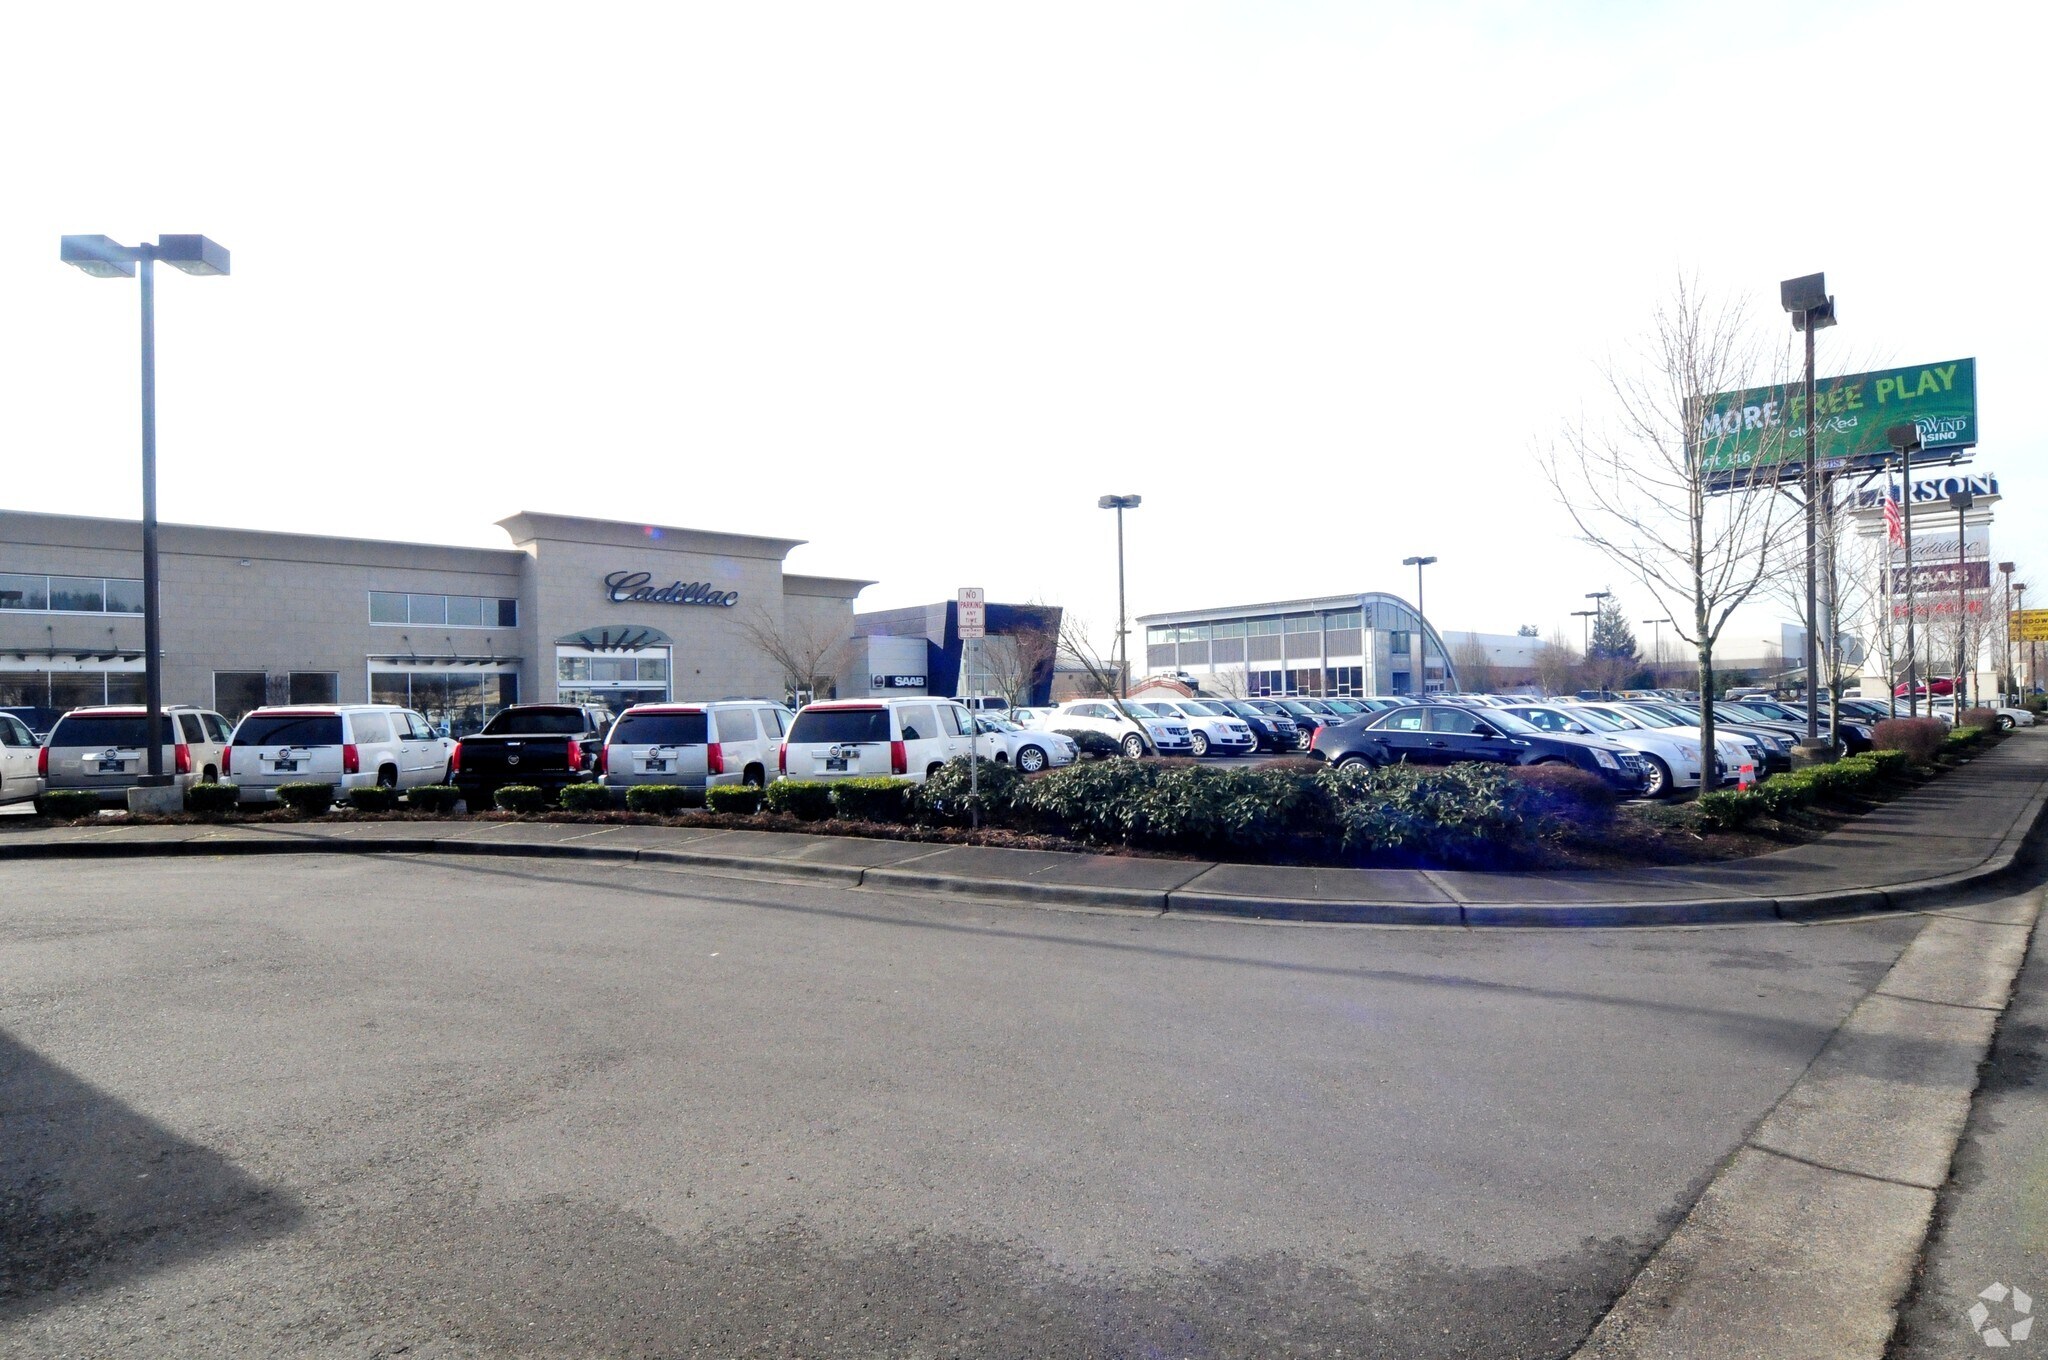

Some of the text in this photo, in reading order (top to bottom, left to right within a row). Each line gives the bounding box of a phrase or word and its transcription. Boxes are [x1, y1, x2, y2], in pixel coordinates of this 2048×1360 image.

[1702, 364, 1957, 439] MORE FREE PLAY
[1822, 416, 1858, 433] Red
[1697, 454, 1721, 468] xit
[1850, 471, 1994, 508] LARSON
[1892, 537, 1979, 559] Cadillac
[1899, 569, 1969, 586] SAAB
[604, 570, 738, 607] Cadillac
[960, 601, 982, 609] PARKING
[894, 676, 925, 686] SAAB
